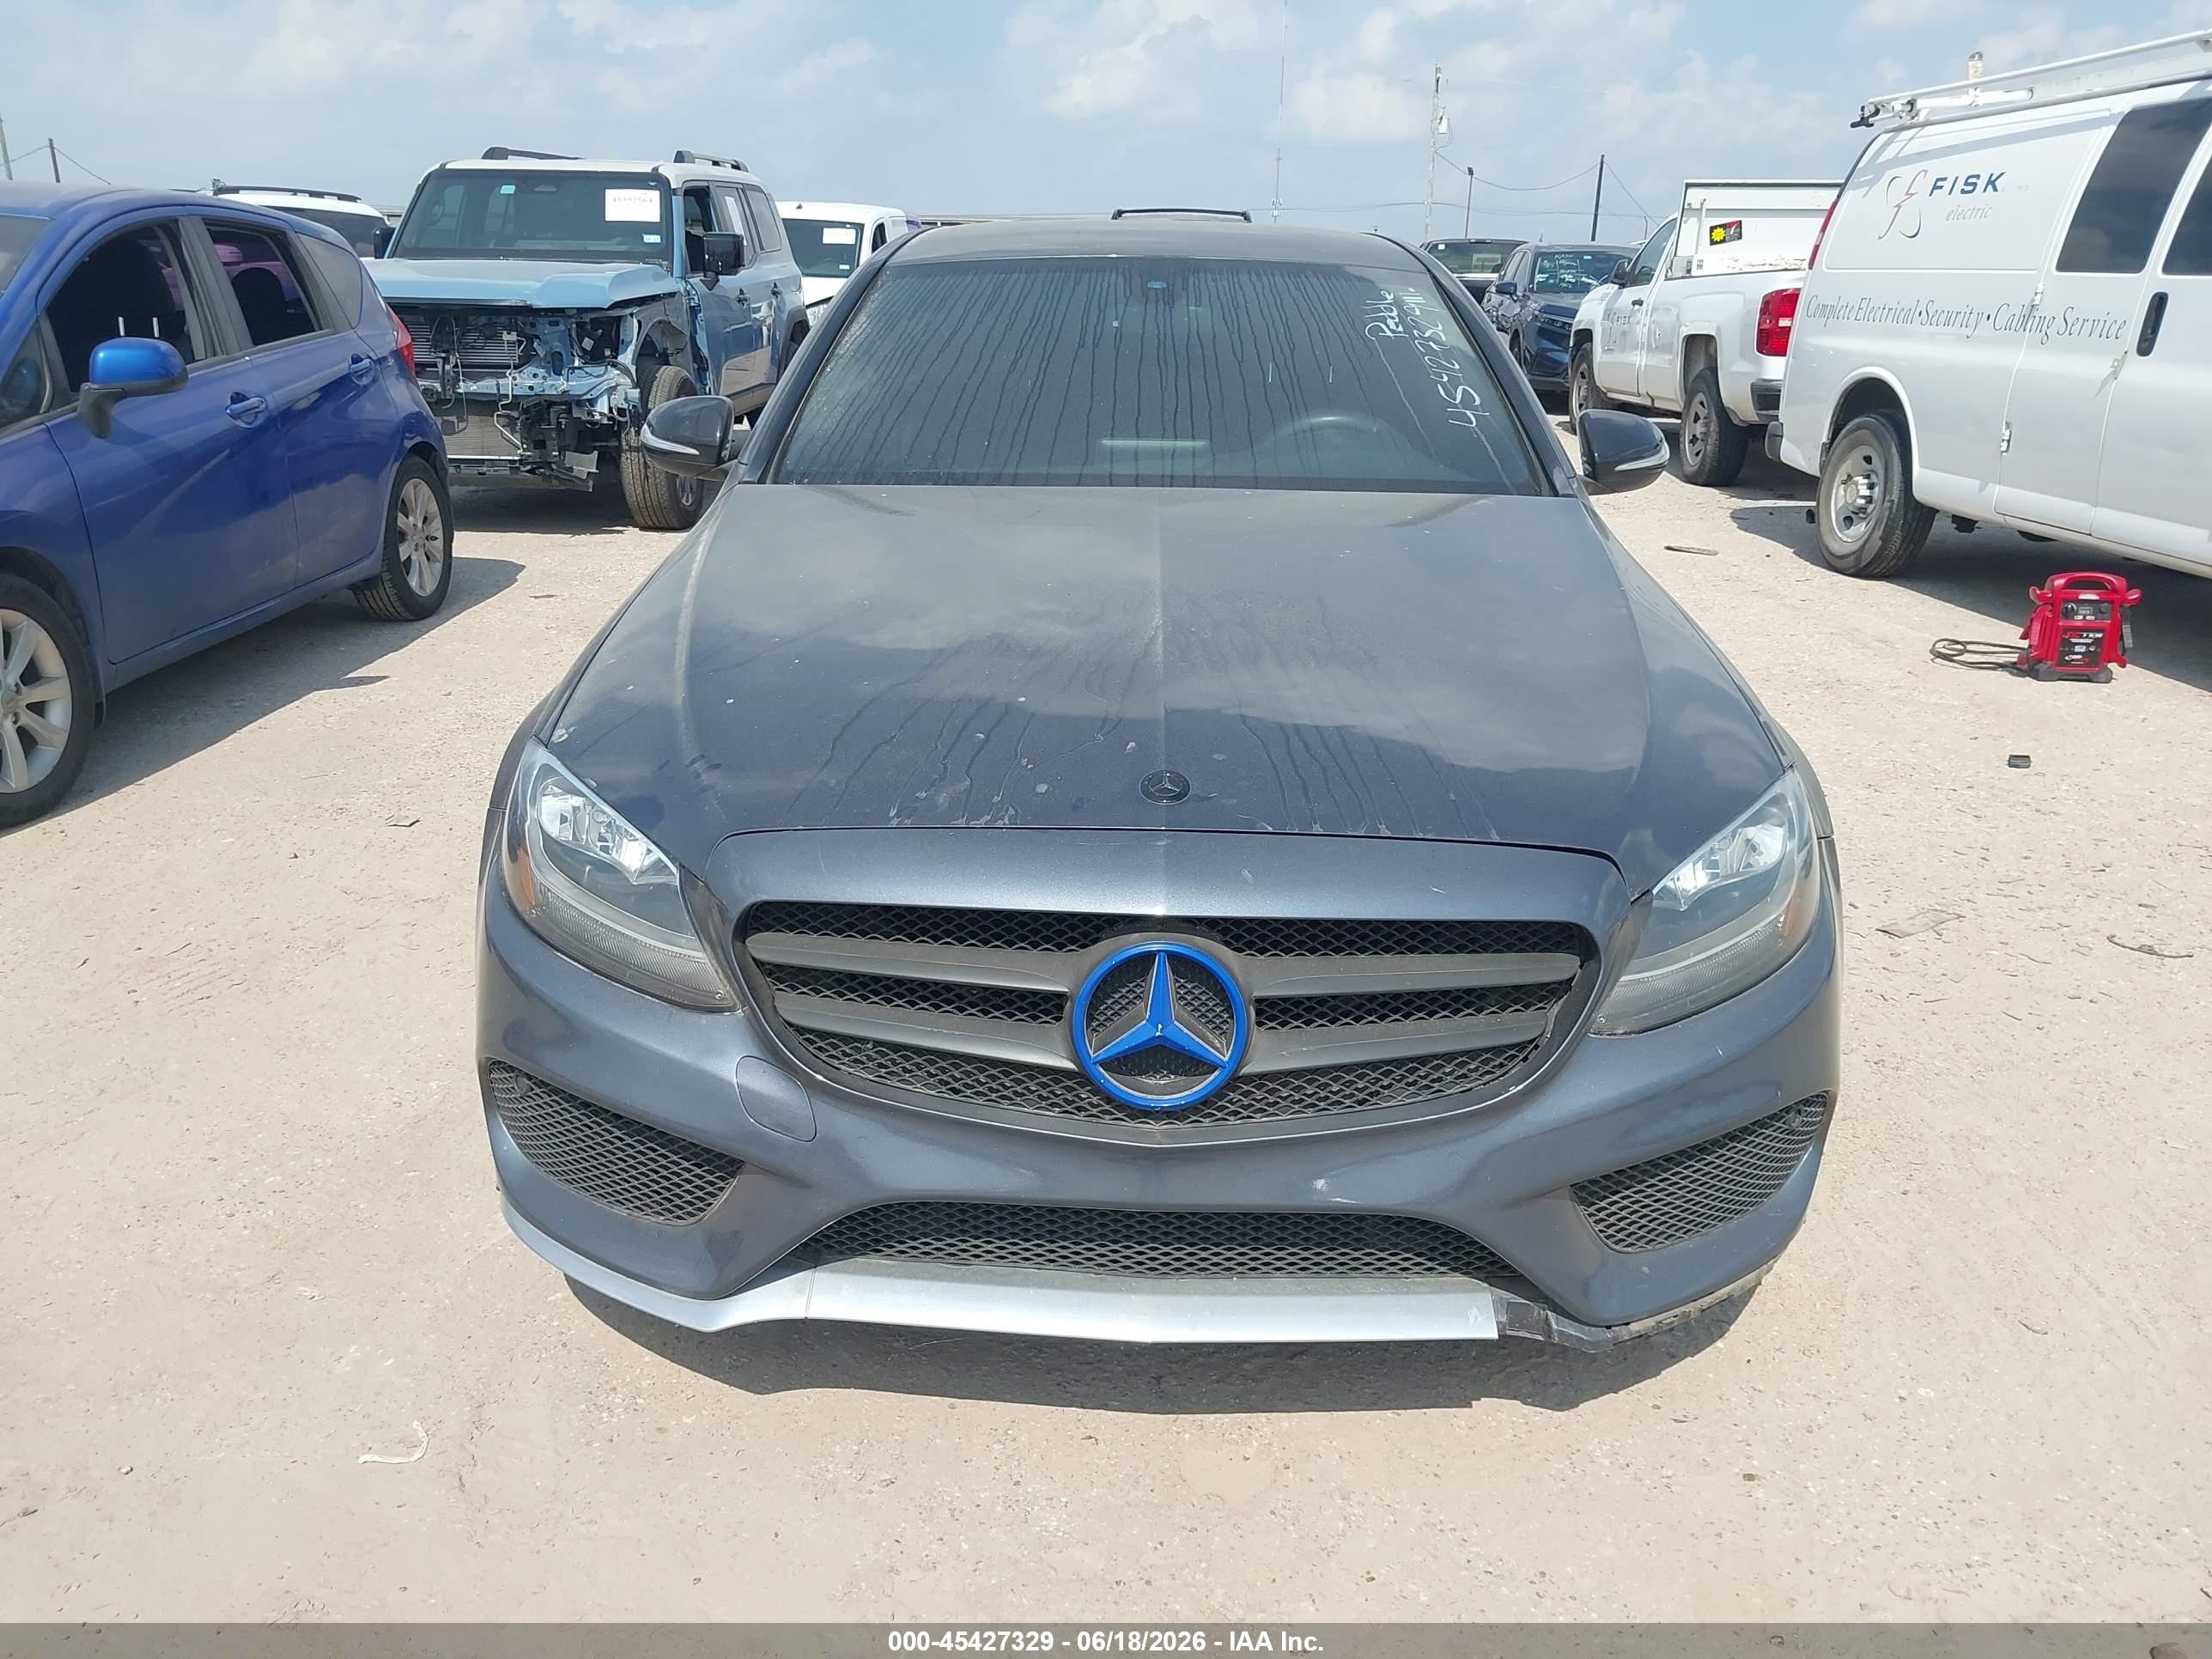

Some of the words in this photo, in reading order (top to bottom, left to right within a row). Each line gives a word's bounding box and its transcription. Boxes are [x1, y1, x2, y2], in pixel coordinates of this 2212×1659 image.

[1929, 172, 2006, 197] FISK
[1946, 204, 1992, 222] electric
[1806, 295, 1855, 328] Complete
[1855, 297, 1920, 325] Electrical
[1920, 300, 1984, 339] Security
[1993, 302, 2056, 345] Cabling
[2057, 306, 2127, 340] Service
